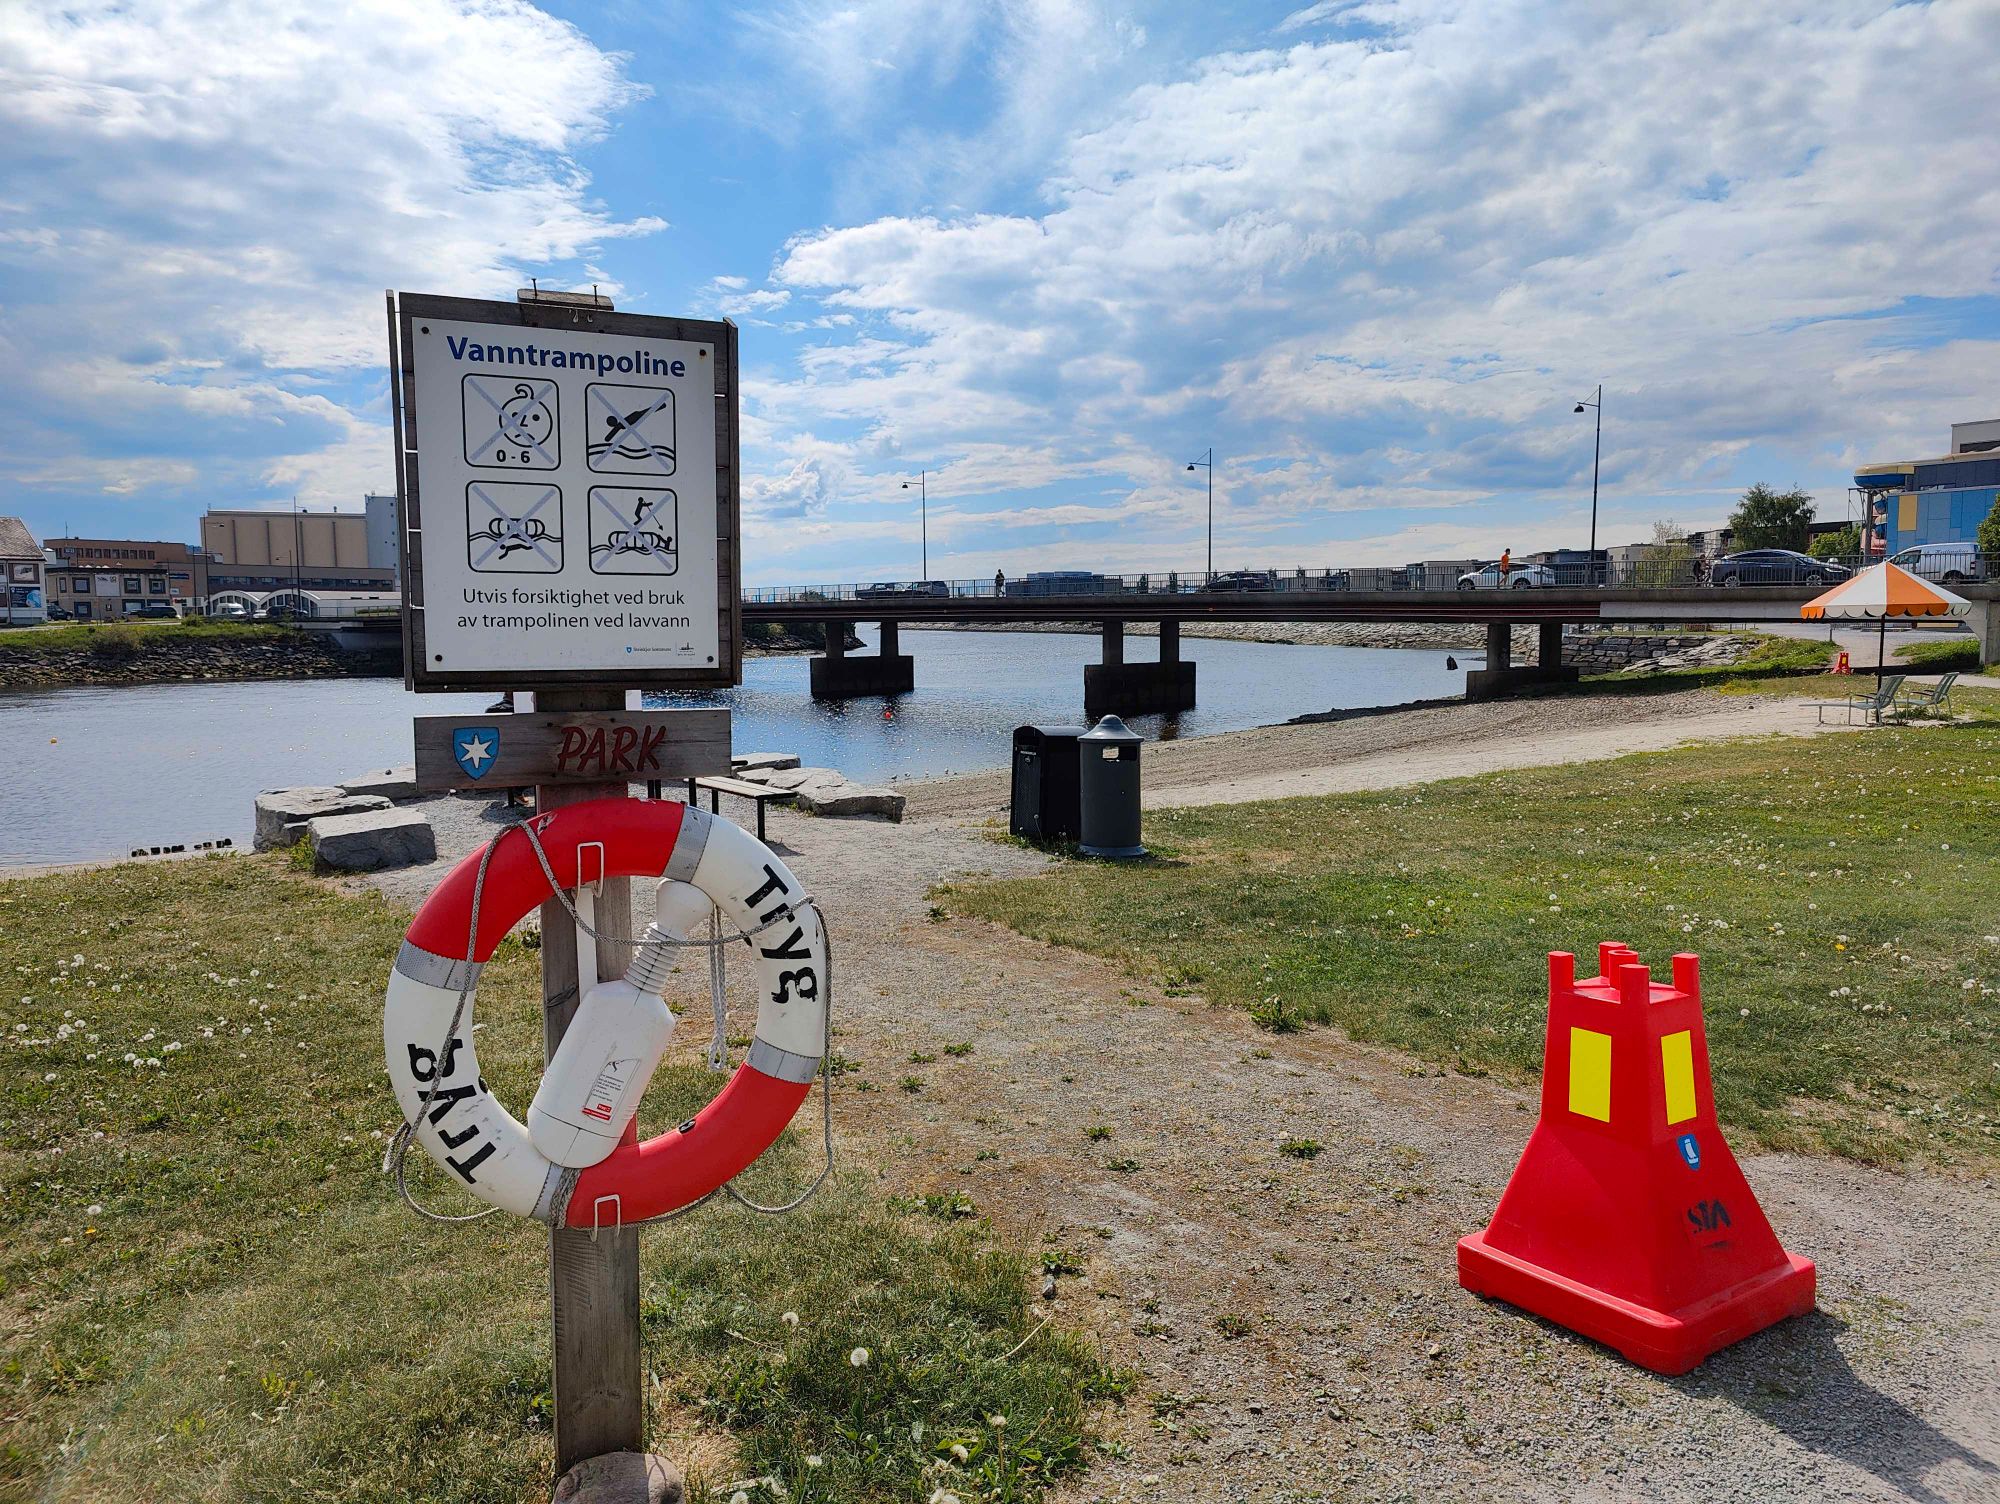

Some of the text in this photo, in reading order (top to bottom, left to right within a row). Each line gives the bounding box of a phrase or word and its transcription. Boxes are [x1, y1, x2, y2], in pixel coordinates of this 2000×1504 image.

[447, 336, 685, 377] Vanntrampoline
[463, 588, 685, 608] Utvis forsiktighet ved bruk
[457, 612, 690, 631] av trampolinen ved lavvann
[557, 725, 667, 772] PARK
[744, 863, 818, 1004] Tryg
[407, 1038, 497, 1184] Tryg
